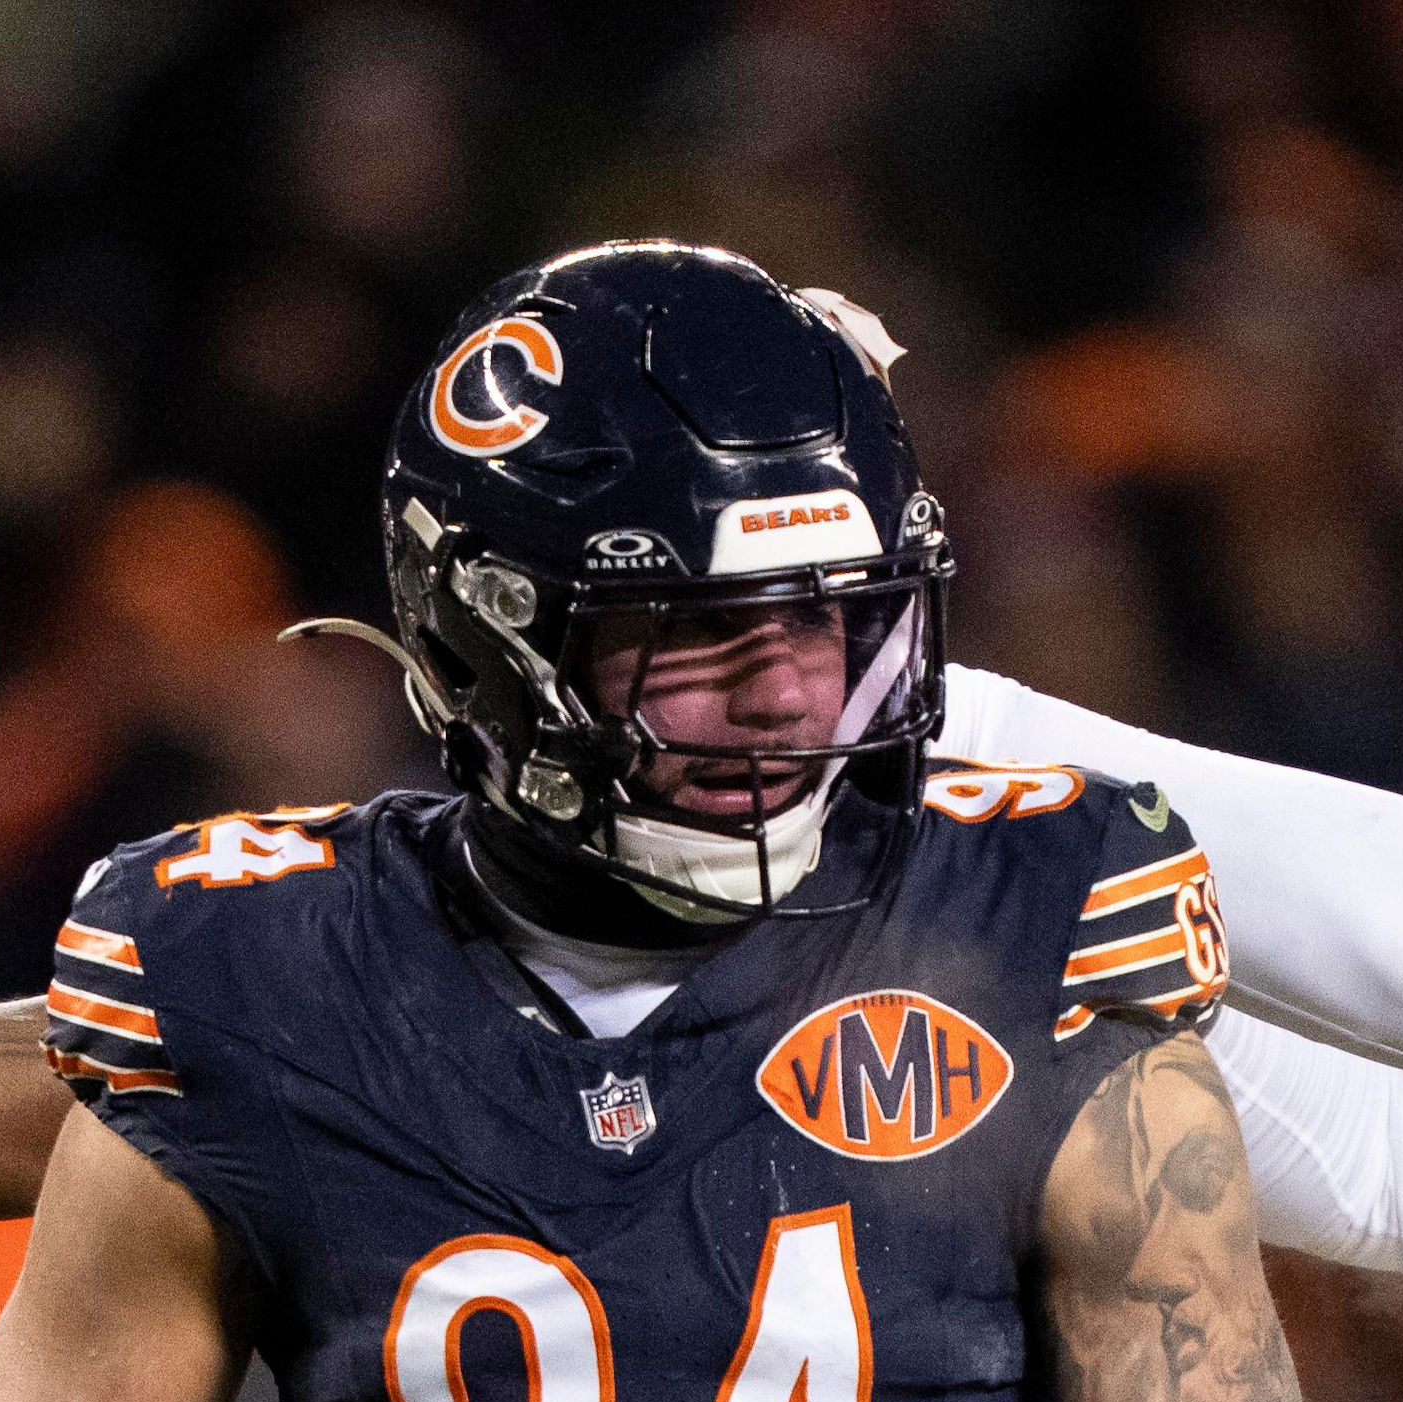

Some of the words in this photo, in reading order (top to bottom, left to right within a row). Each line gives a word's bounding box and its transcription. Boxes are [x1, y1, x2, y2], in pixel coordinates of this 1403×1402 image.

[429, 317, 564, 458] C
[741, 503, 850, 533] BEARS
[587, 556, 671, 570] OAKLEY
[924, 763, 1086, 824] 9
[791, 1006, 981, 1144] VMH
[598, 1106, 643, 1137] NFL
